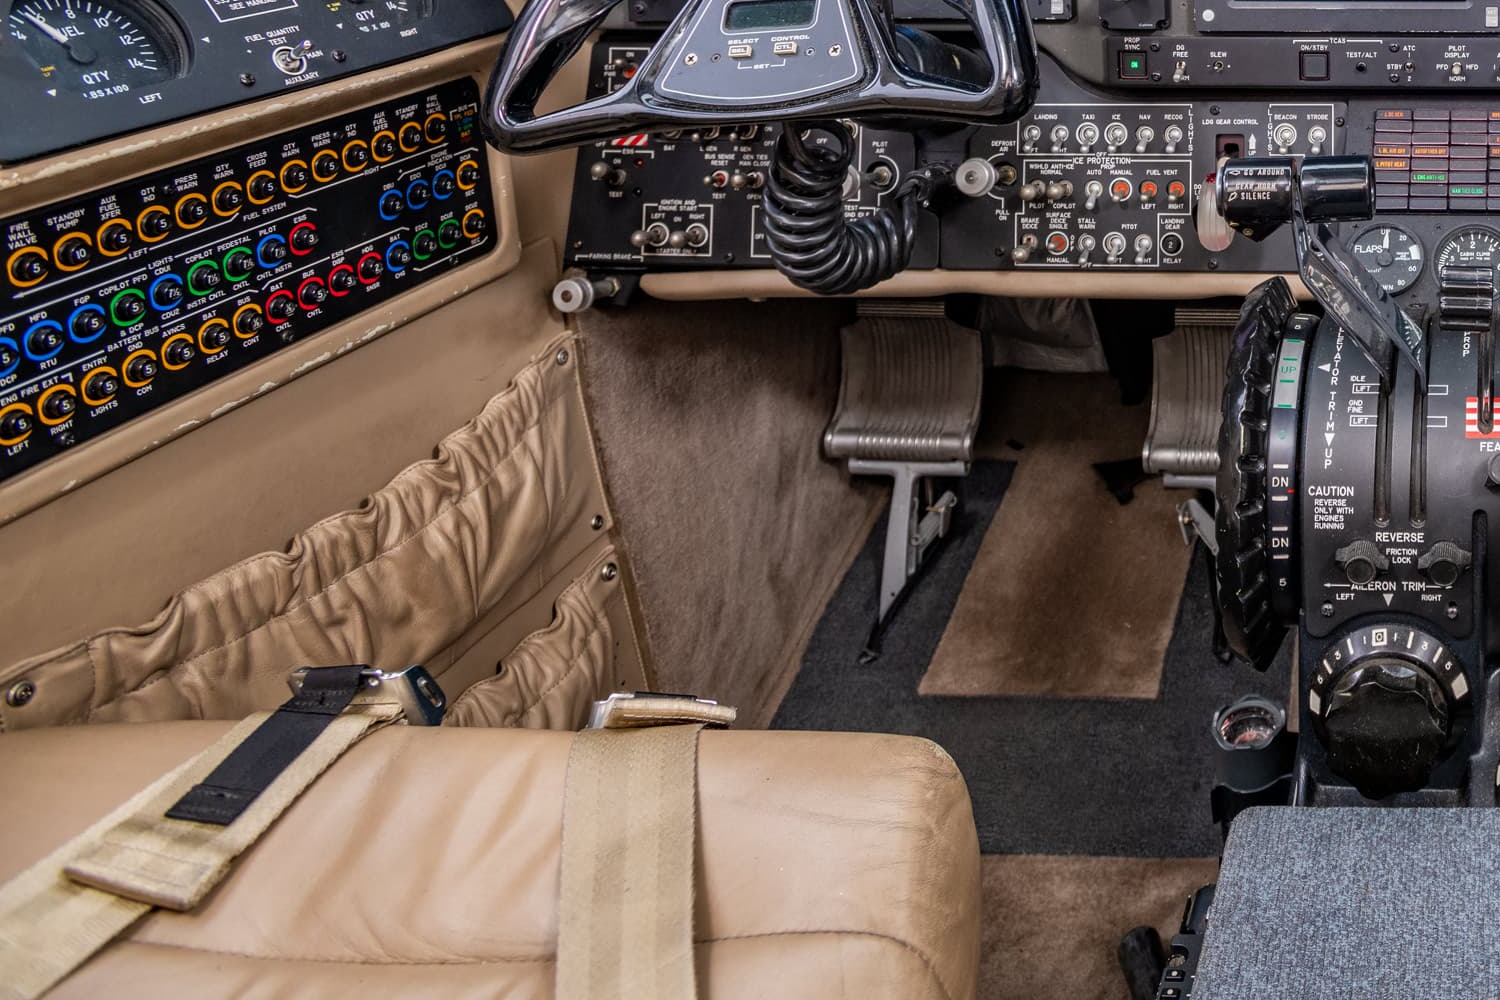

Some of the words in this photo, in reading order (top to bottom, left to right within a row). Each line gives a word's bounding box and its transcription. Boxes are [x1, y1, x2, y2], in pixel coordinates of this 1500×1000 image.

[94, 17, 109, 28] 10
[400, 27, 418, 38] RIGHT
[120, 35, 134, 45] 12
[268, 36, 287, 46] TEST
[128, 58, 143, 68] 14
[82, 70, 110, 84] QTY
[246, 151, 267, 162] CROSS
[1240, 192, 1271, 200] SILENCE
[262, 202, 287, 215] SYSTEM
[47, 208, 85, 227] STANDBY
[56, 219, 79, 231] PUMP
[217, 235, 251, 252] PEDESTAL
[128, 247, 148, 260] LEFT
[107, 335, 142, 353] BATTERY
[144, 326, 159, 337] BUS
[206, 350, 229, 364] RELAY
[40, 358, 57, 370] RTU
[91, 400, 118, 418] LIGHTS
[1272, 477, 1288, 487] DN
[1308, 486, 1354, 496] CAUTION
[1376, 532, 1424, 542] REVERSE
[1402, 581, 1425, 591] TRIM
